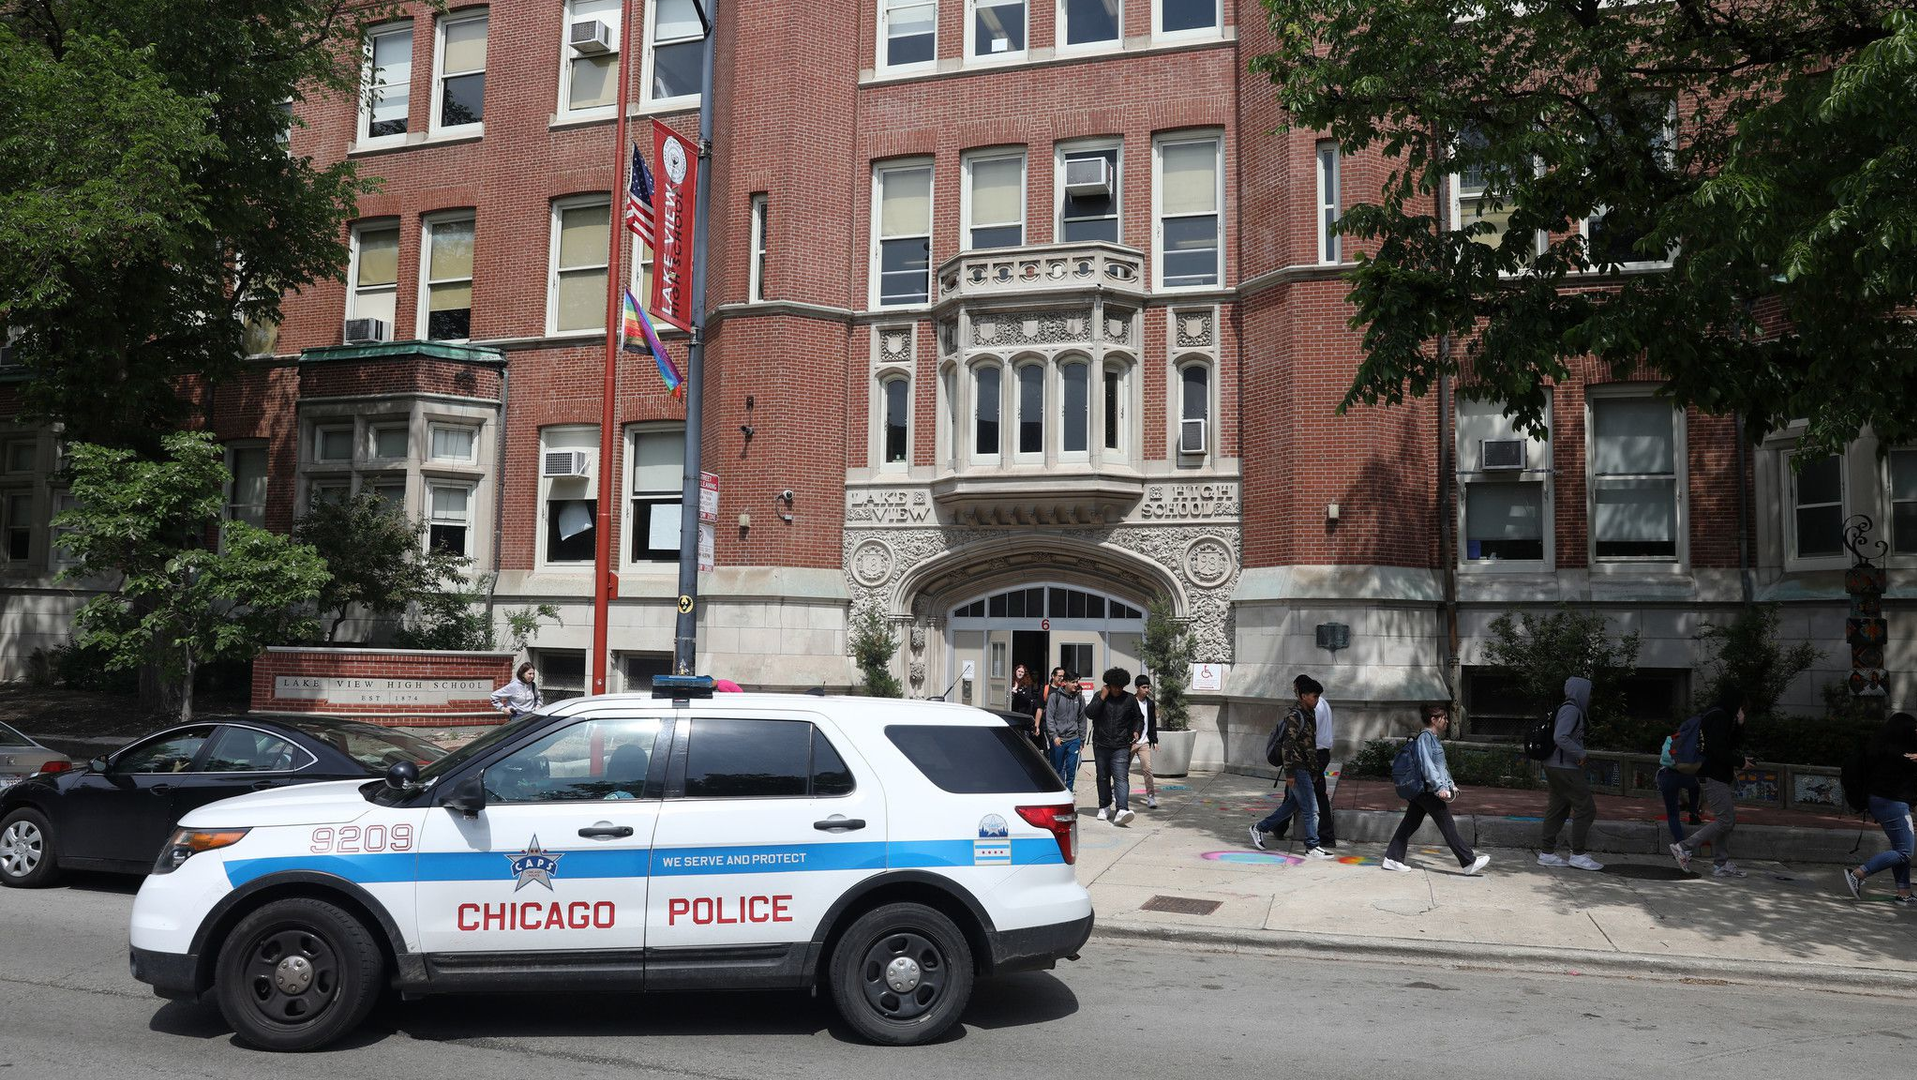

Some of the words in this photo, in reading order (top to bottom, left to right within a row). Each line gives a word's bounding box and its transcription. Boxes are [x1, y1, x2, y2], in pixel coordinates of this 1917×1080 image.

[663, 183, 678, 250] VIEW
[673, 190, 684, 267] SCHOOL
[661, 252, 675, 316] LAKE
[671, 273, 682, 319] HIGH
[699, 480, 718, 490] LEANING
[1172, 485, 1234, 502] HIGH
[851, 491, 908, 508] LAKE
[872, 507, 931, 523] VIEW
[1141, 502, 1214, 519] SCHOOL
[1041, 618, 1050, 631] 6
[283, 678, 320, 688] LAKE
[336, 680, 374, 688] VIEW
[387, 681, 424, 689] HIGH
[433, 681, 484, 689] SCHOOL
[310, 823, 414, 854] 9209
[515, 858, 554, 871] CAPS
[663, 856, 682, 867] WE
[684, 855, 724, 867] SERVE
[726, 854, 750, 865] AND
[752, 852, 807, 864] PROTECT
[457, 901, 616, 932] CHICAGO
[668, 894, 793, 926] POLICE
